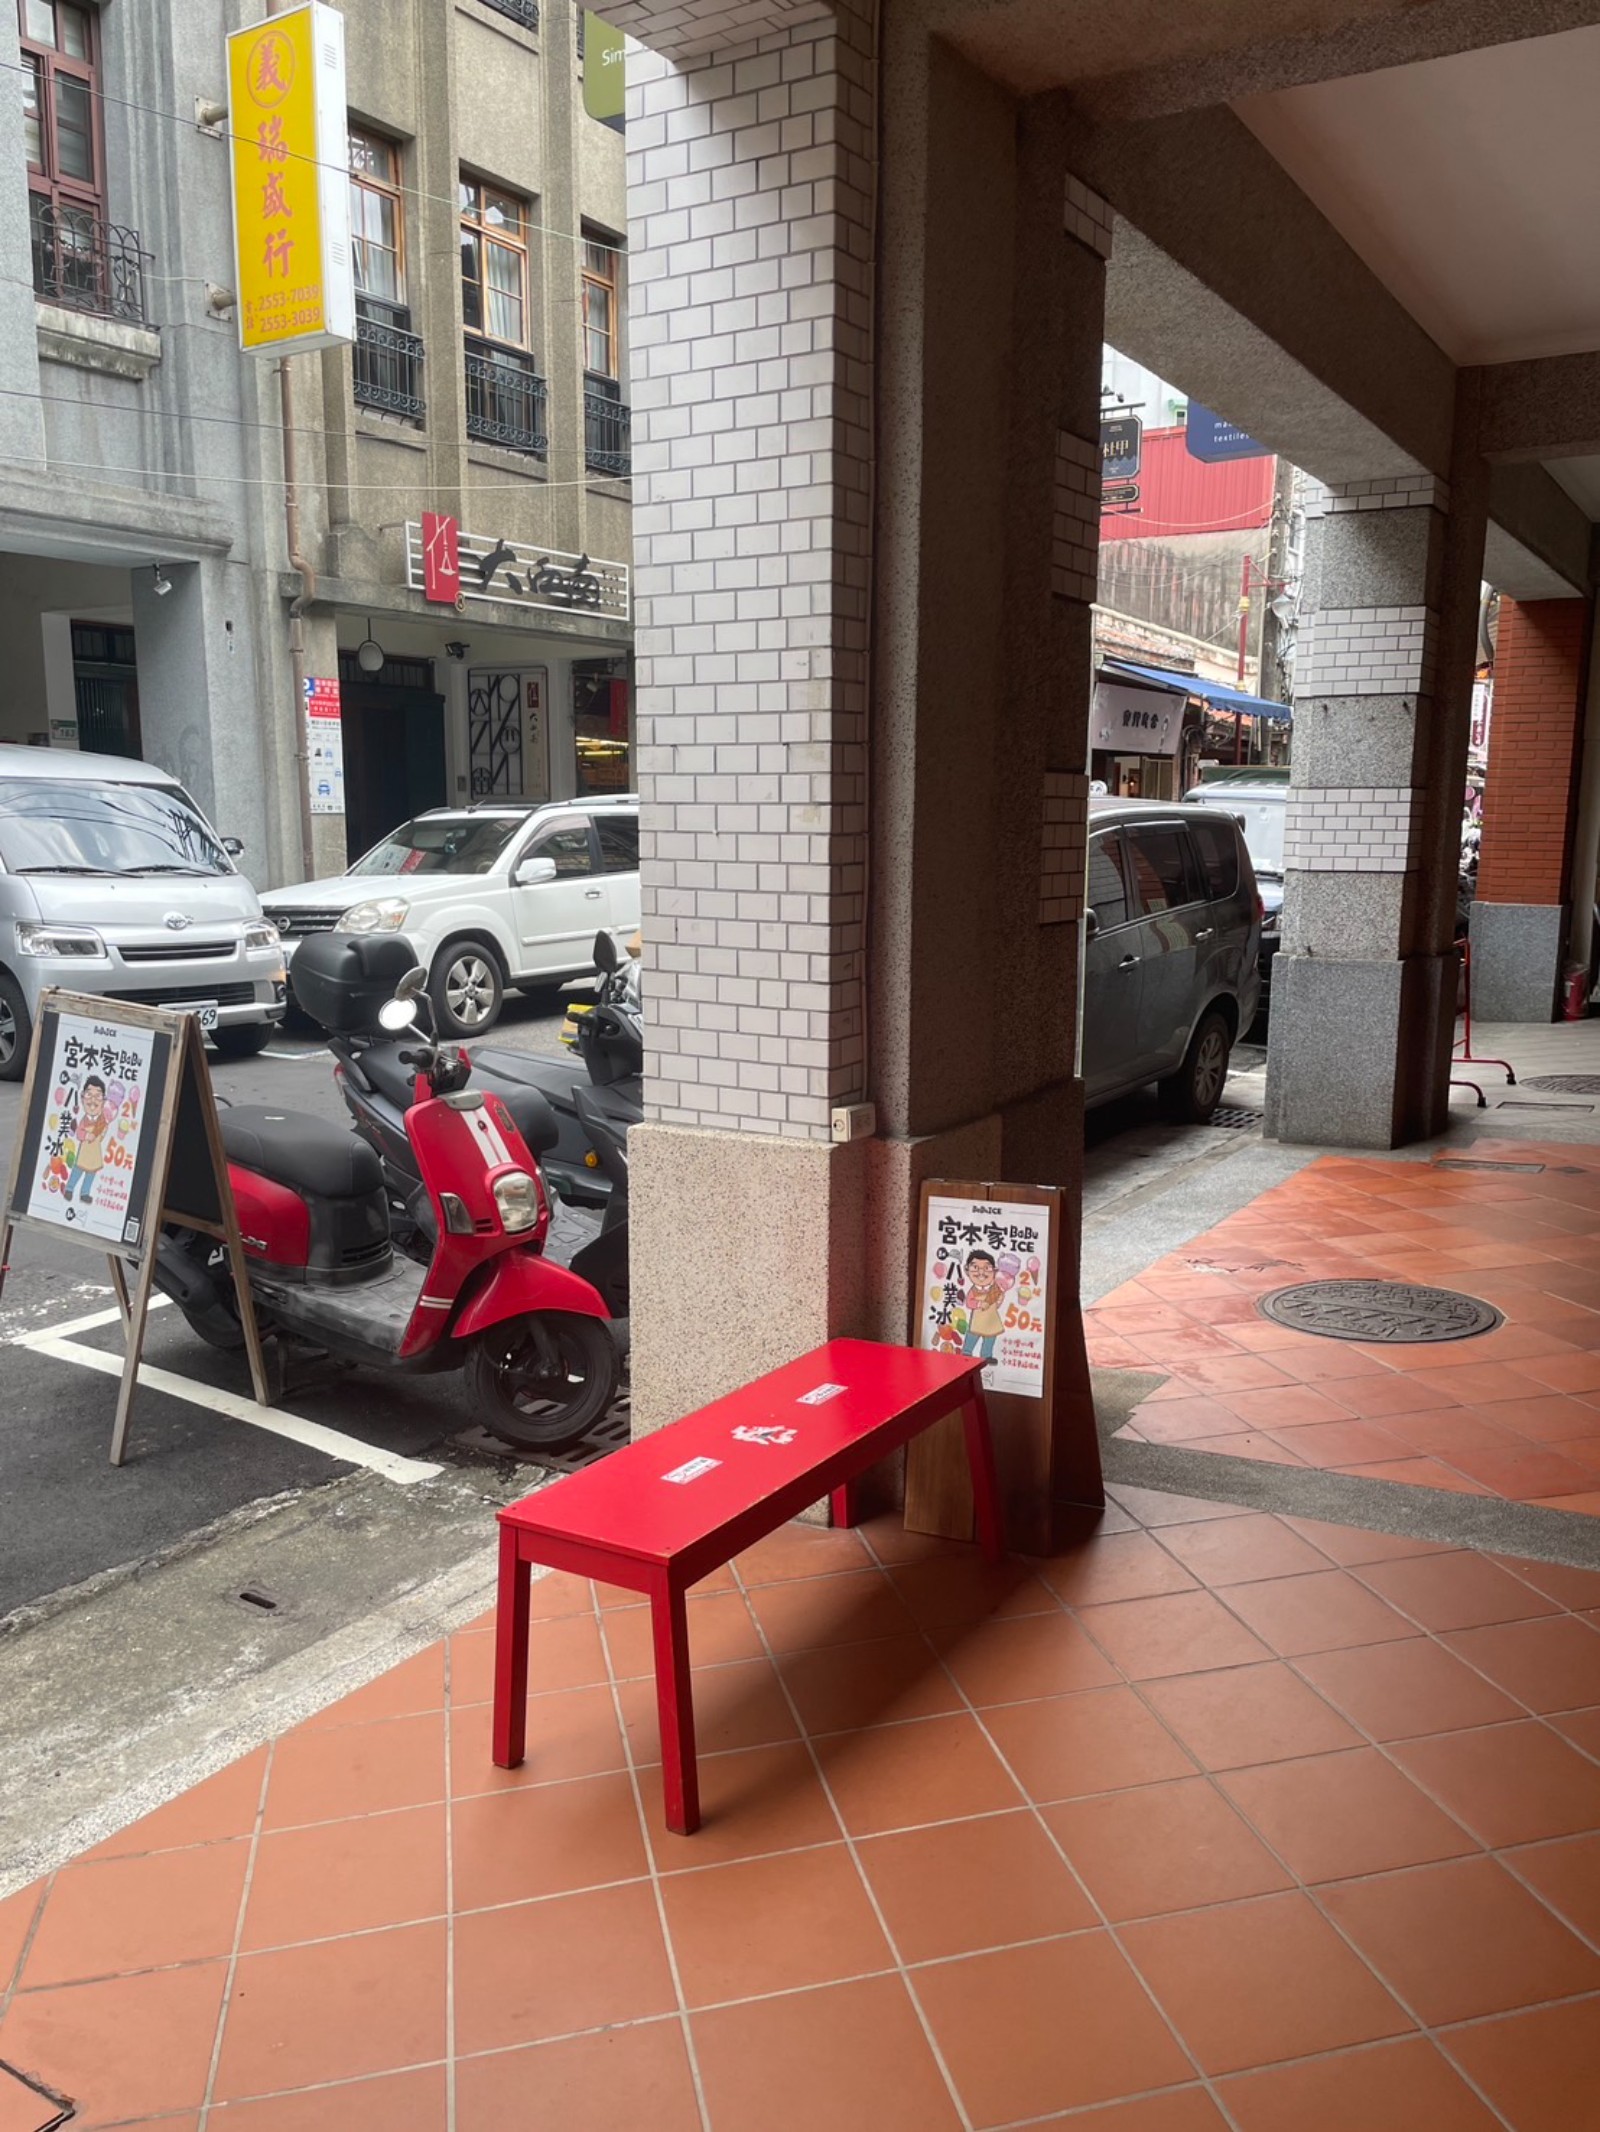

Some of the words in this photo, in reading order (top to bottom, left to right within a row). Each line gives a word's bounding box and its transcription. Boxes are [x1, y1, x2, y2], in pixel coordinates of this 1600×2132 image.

[259, 307, 322, 333] 2553-3039
[64, 1035, 119, 1077] 宮本家
[118, 1066, 139, 1081] ICE
[938, 1215, 1009, 1250] 宮本家
[1009, 1224, 1039, 1240] BaBu
[1010, 1239, 1035, 1253] ICE
[1003, 1302, 1042, 1333] 50元
